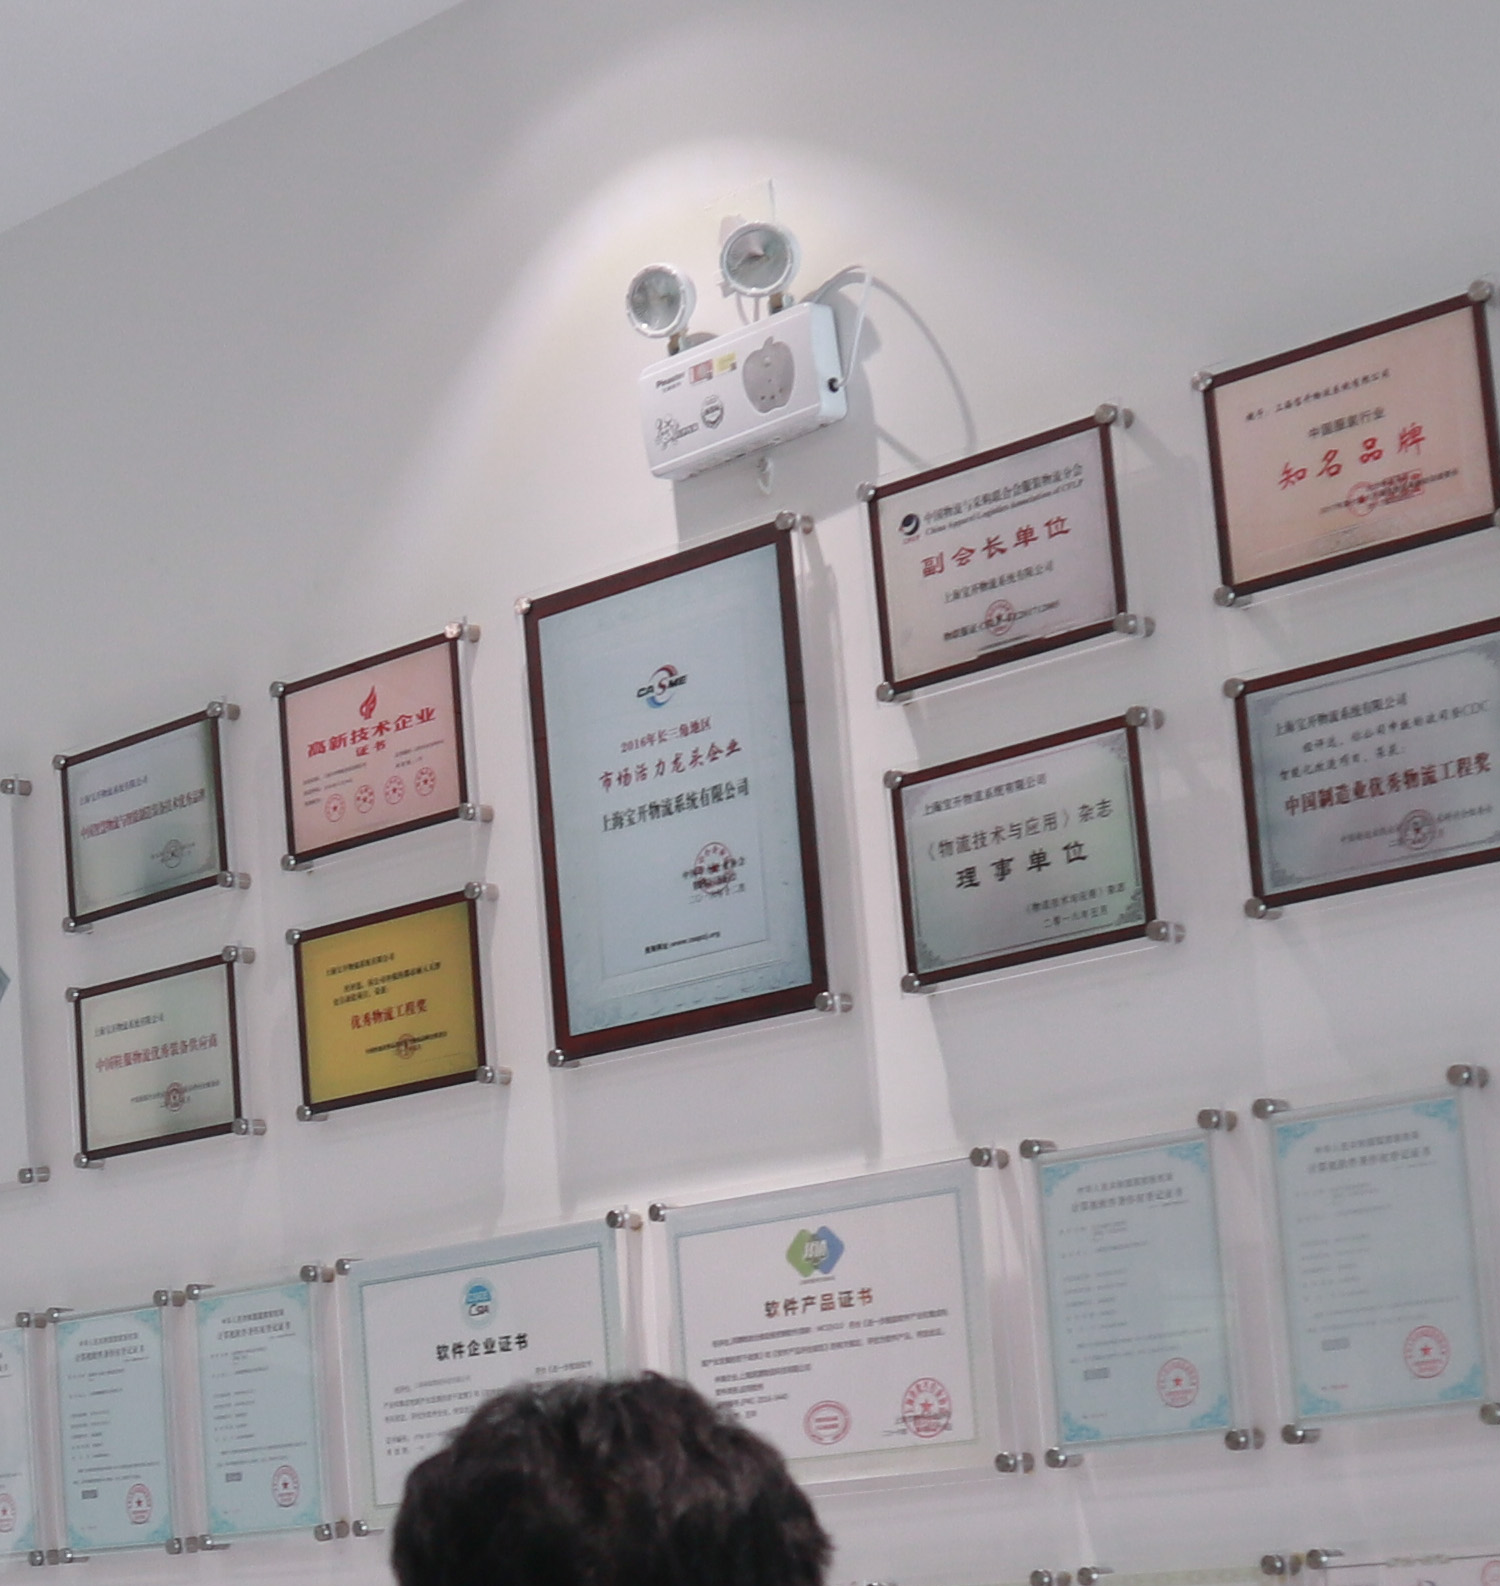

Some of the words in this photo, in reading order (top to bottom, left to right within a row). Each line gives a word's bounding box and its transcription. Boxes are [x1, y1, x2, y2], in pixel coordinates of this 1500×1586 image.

[1278, 422, 1427, 490] 知名品牌
[921, 515, 1072, 578] 副会长单位
[307, 707, 436, 758] 高新技术企业
[356, 740, 386, 757] 证书
[599, 738, 742, 791] 市场活力龙头企业
[602, 776, 750, 833] 上海宝开物流系统有限公司
[956, 840, 1088, 889] 理事单位
[764, 1287, 874, 1319] 软件产品证书
[436, 1332, 529, 1361] 软件企业证书
